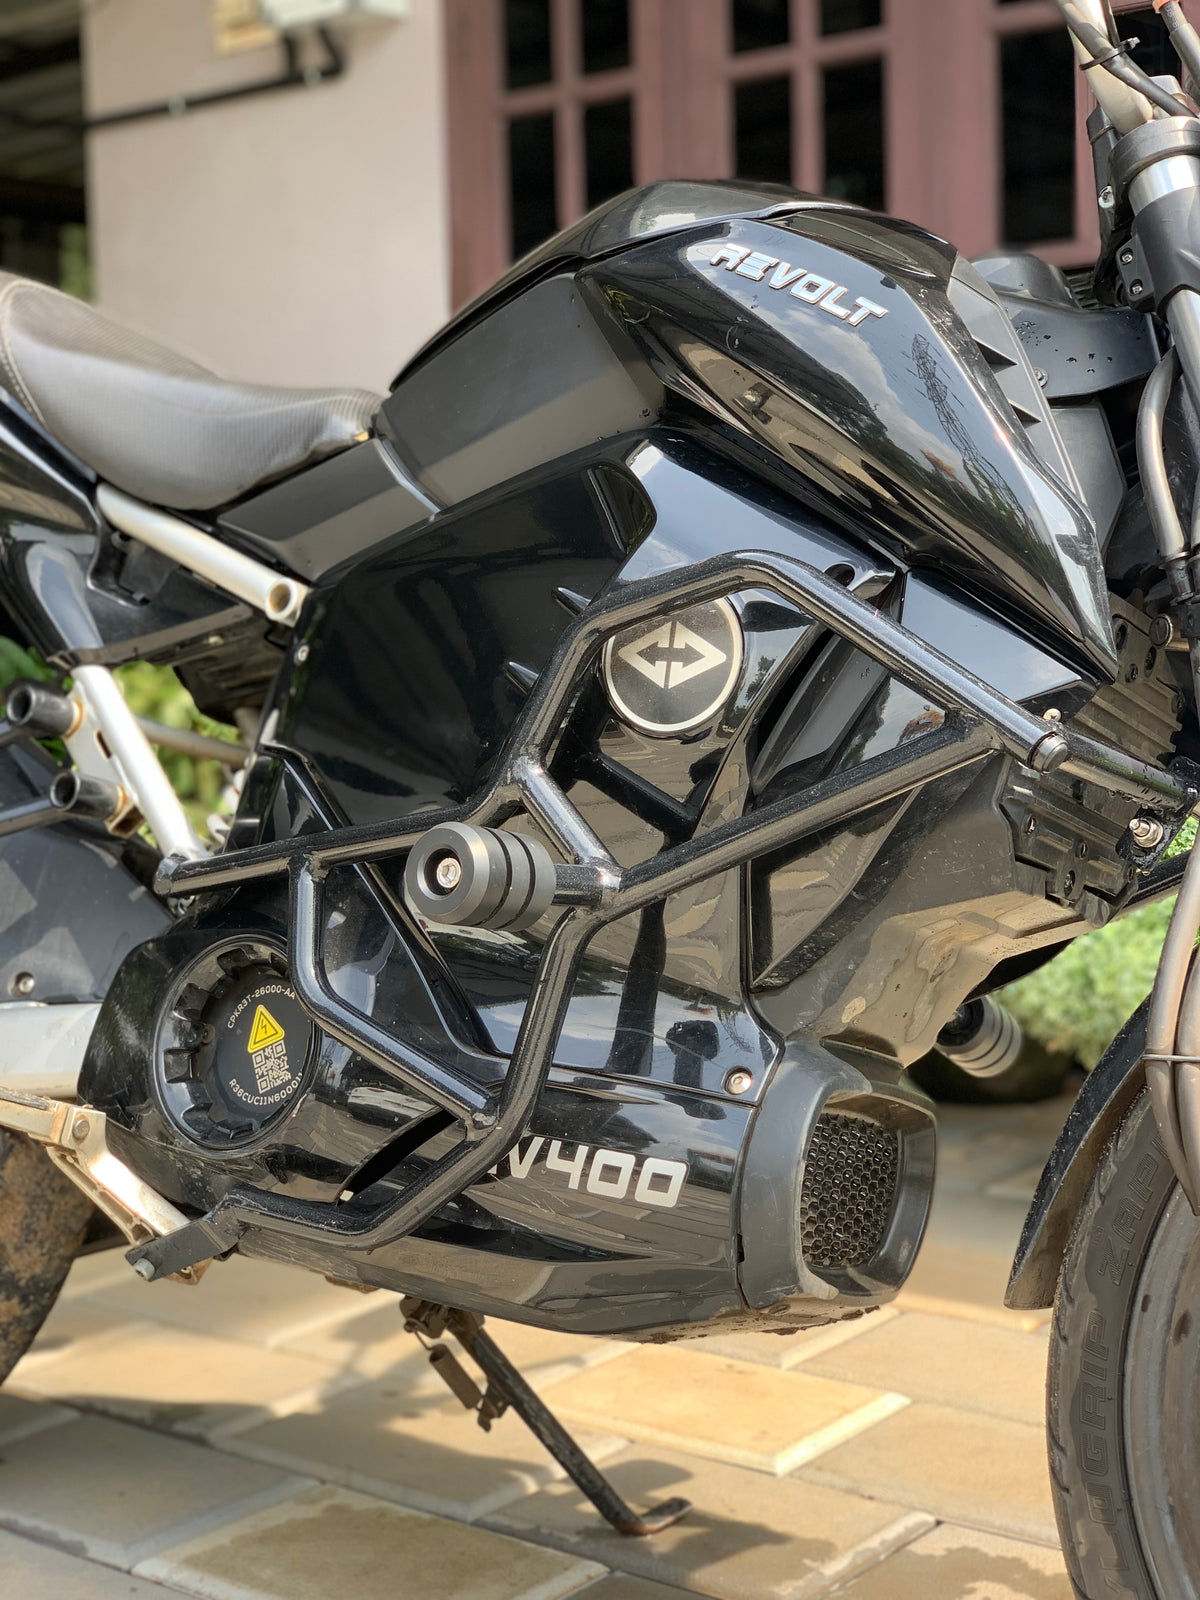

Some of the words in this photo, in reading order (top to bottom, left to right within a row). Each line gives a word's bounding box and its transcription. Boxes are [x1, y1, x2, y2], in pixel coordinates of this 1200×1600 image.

[710, 243, 888, 327] REVOLT
[487, 1136, 689, 1208] V400
[1096, 1135, 1170, 1287] ZAP
